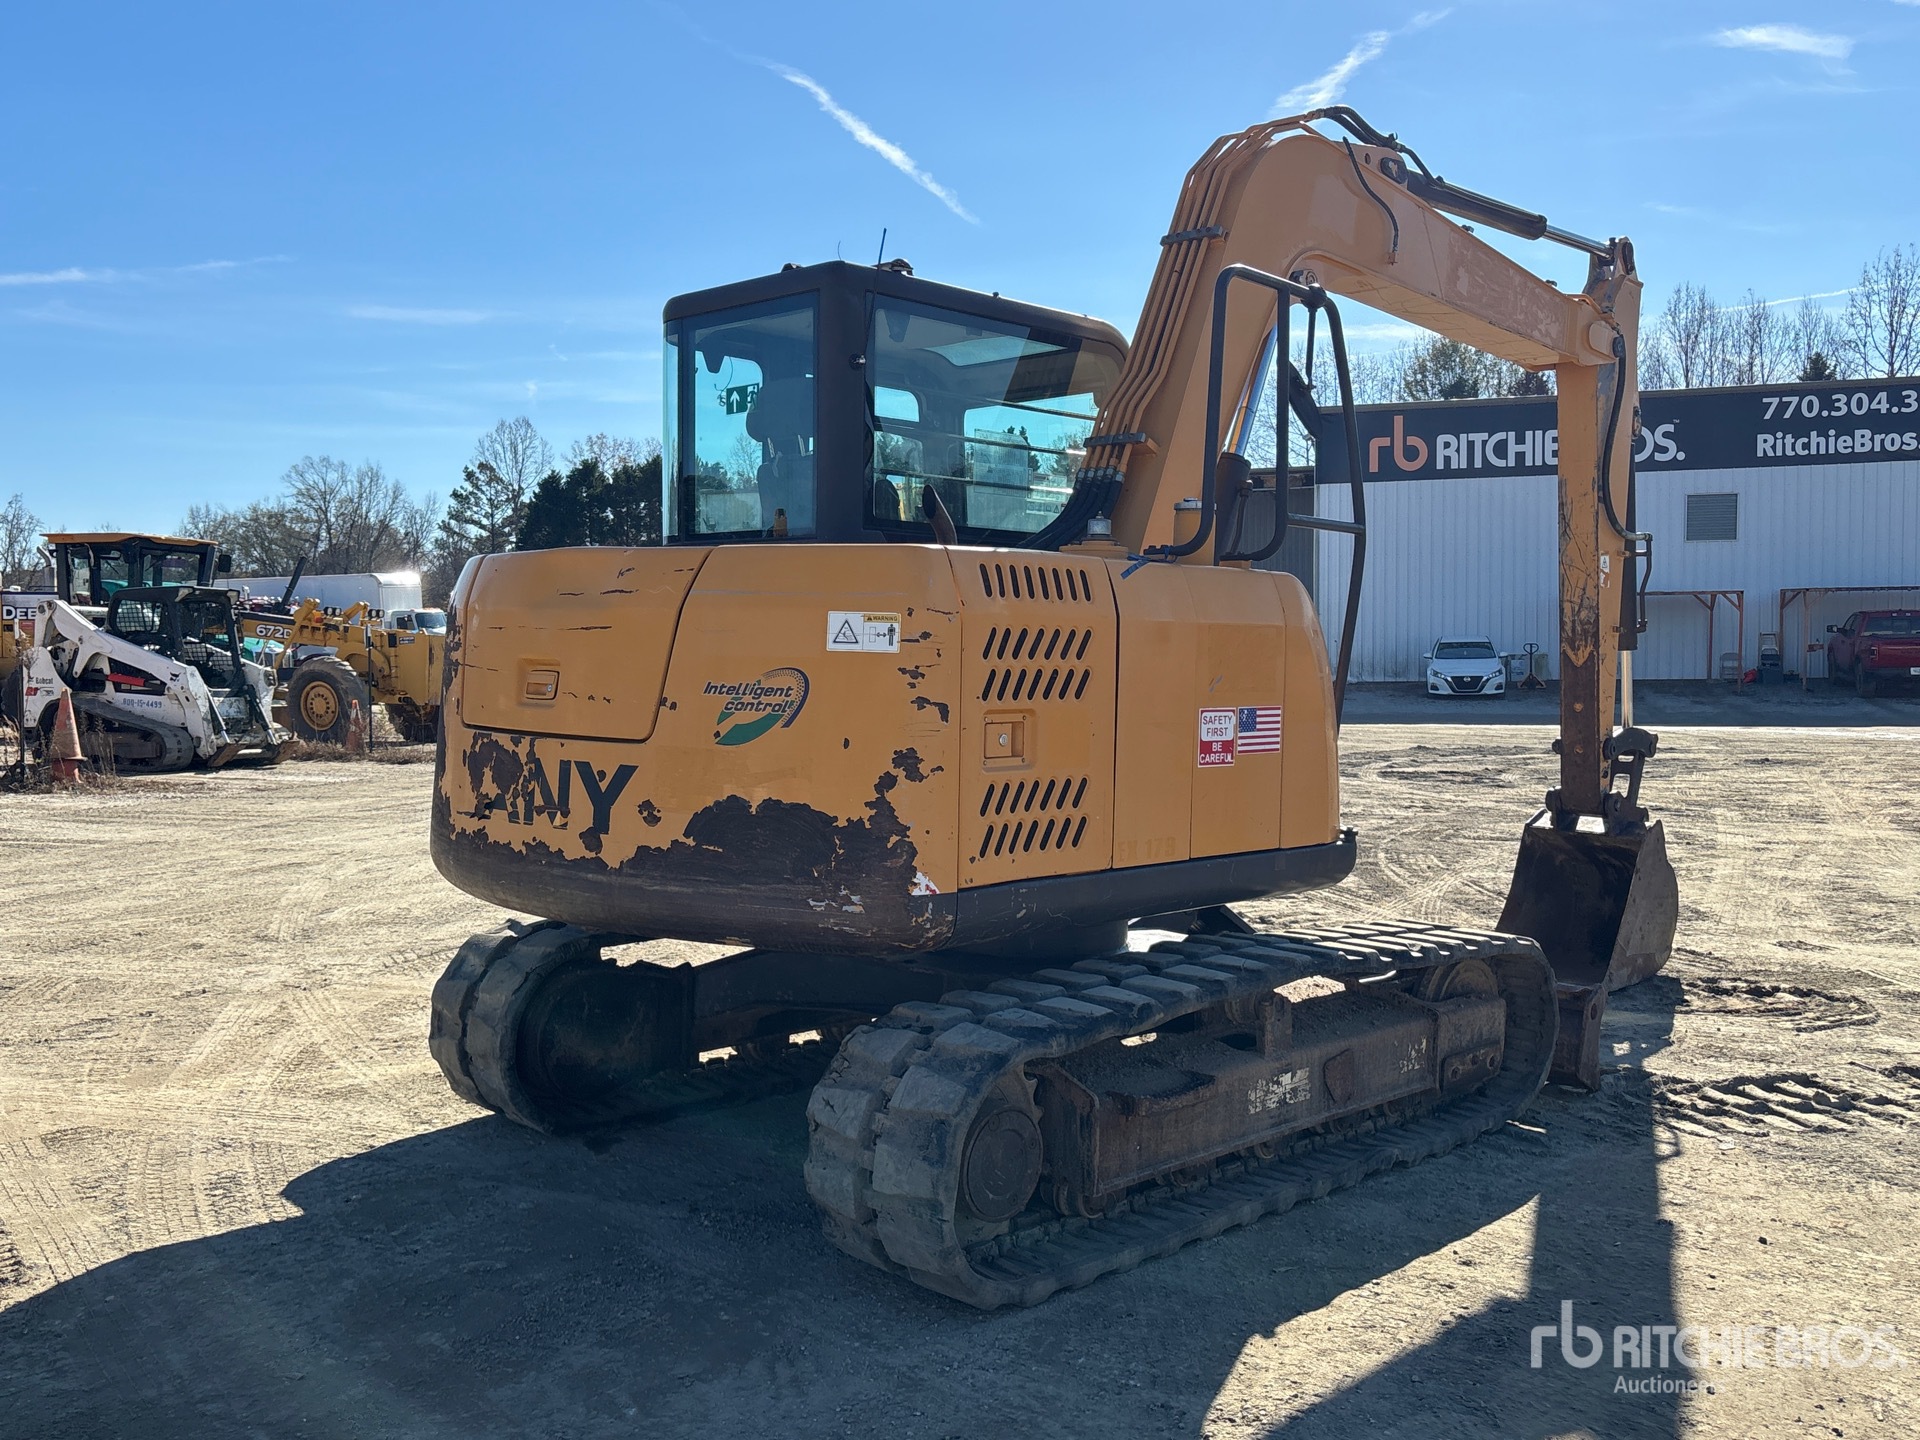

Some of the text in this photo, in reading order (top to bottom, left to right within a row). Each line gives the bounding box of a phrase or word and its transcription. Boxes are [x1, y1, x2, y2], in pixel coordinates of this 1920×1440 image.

[1762, 389, 1919, 420] 770.304.3
[1369, 415, 1429, 473] rb
[1436, 429, 1558, 470] RITCHIE
[256, 624, 292, 639] 672D
[35, 677, 54, 685] Bobcat
[703, 681, 794, 700] Intelligent
[723, 699, 790, 714] control
[1202, 715, 1233, 726] SAFETY
[1206, 727, 1228, 737] FIRST
[1212, 742, 1222, 752] BE
[1200, 753, 1233, 764] CAREFUL
